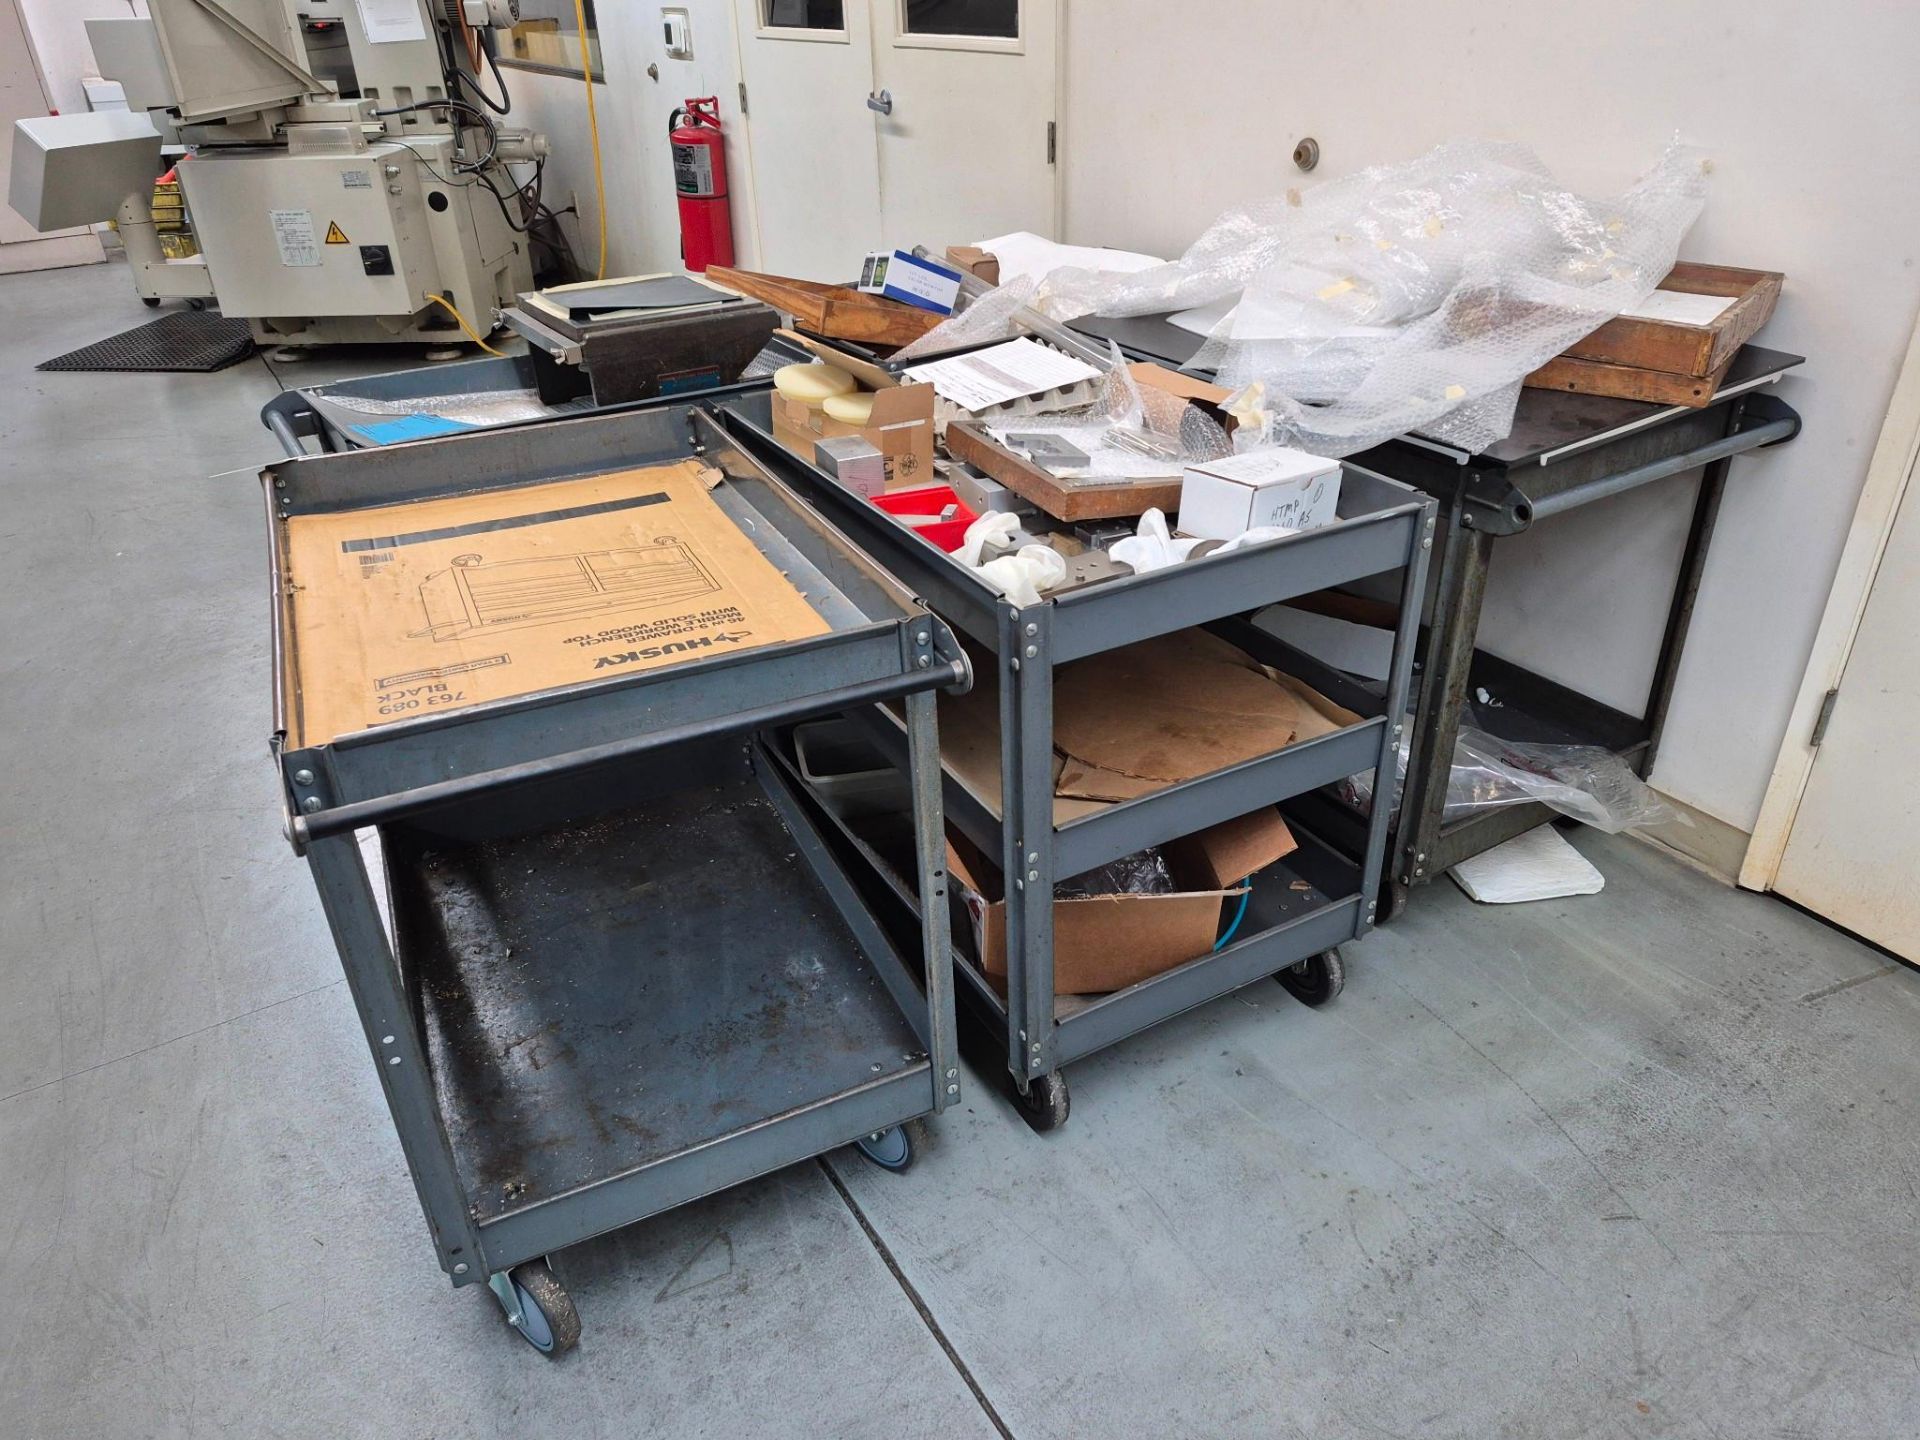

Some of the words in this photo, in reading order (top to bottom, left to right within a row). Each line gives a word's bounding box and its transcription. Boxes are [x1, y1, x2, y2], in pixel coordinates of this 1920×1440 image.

[1297, 509, 1312, 527] AS
[652, 613, 697, 626] SOLID
[685, 611, 742, 627] MOBILE
[701, 606, 738, 618] WITH
[579, 622, 681, 648] WORKBENCH
[598, 623, 648, 637] WOOD
[627, 622, 709, 644] 9-DRAWER
[562, 632, 592, 644] TOP
[594, 636, 713, 669] HUSKY
[377, 683, 448, 703] BLACK
[427, 691, 467, 705] 763
[378, 700, 420, 715] 089
